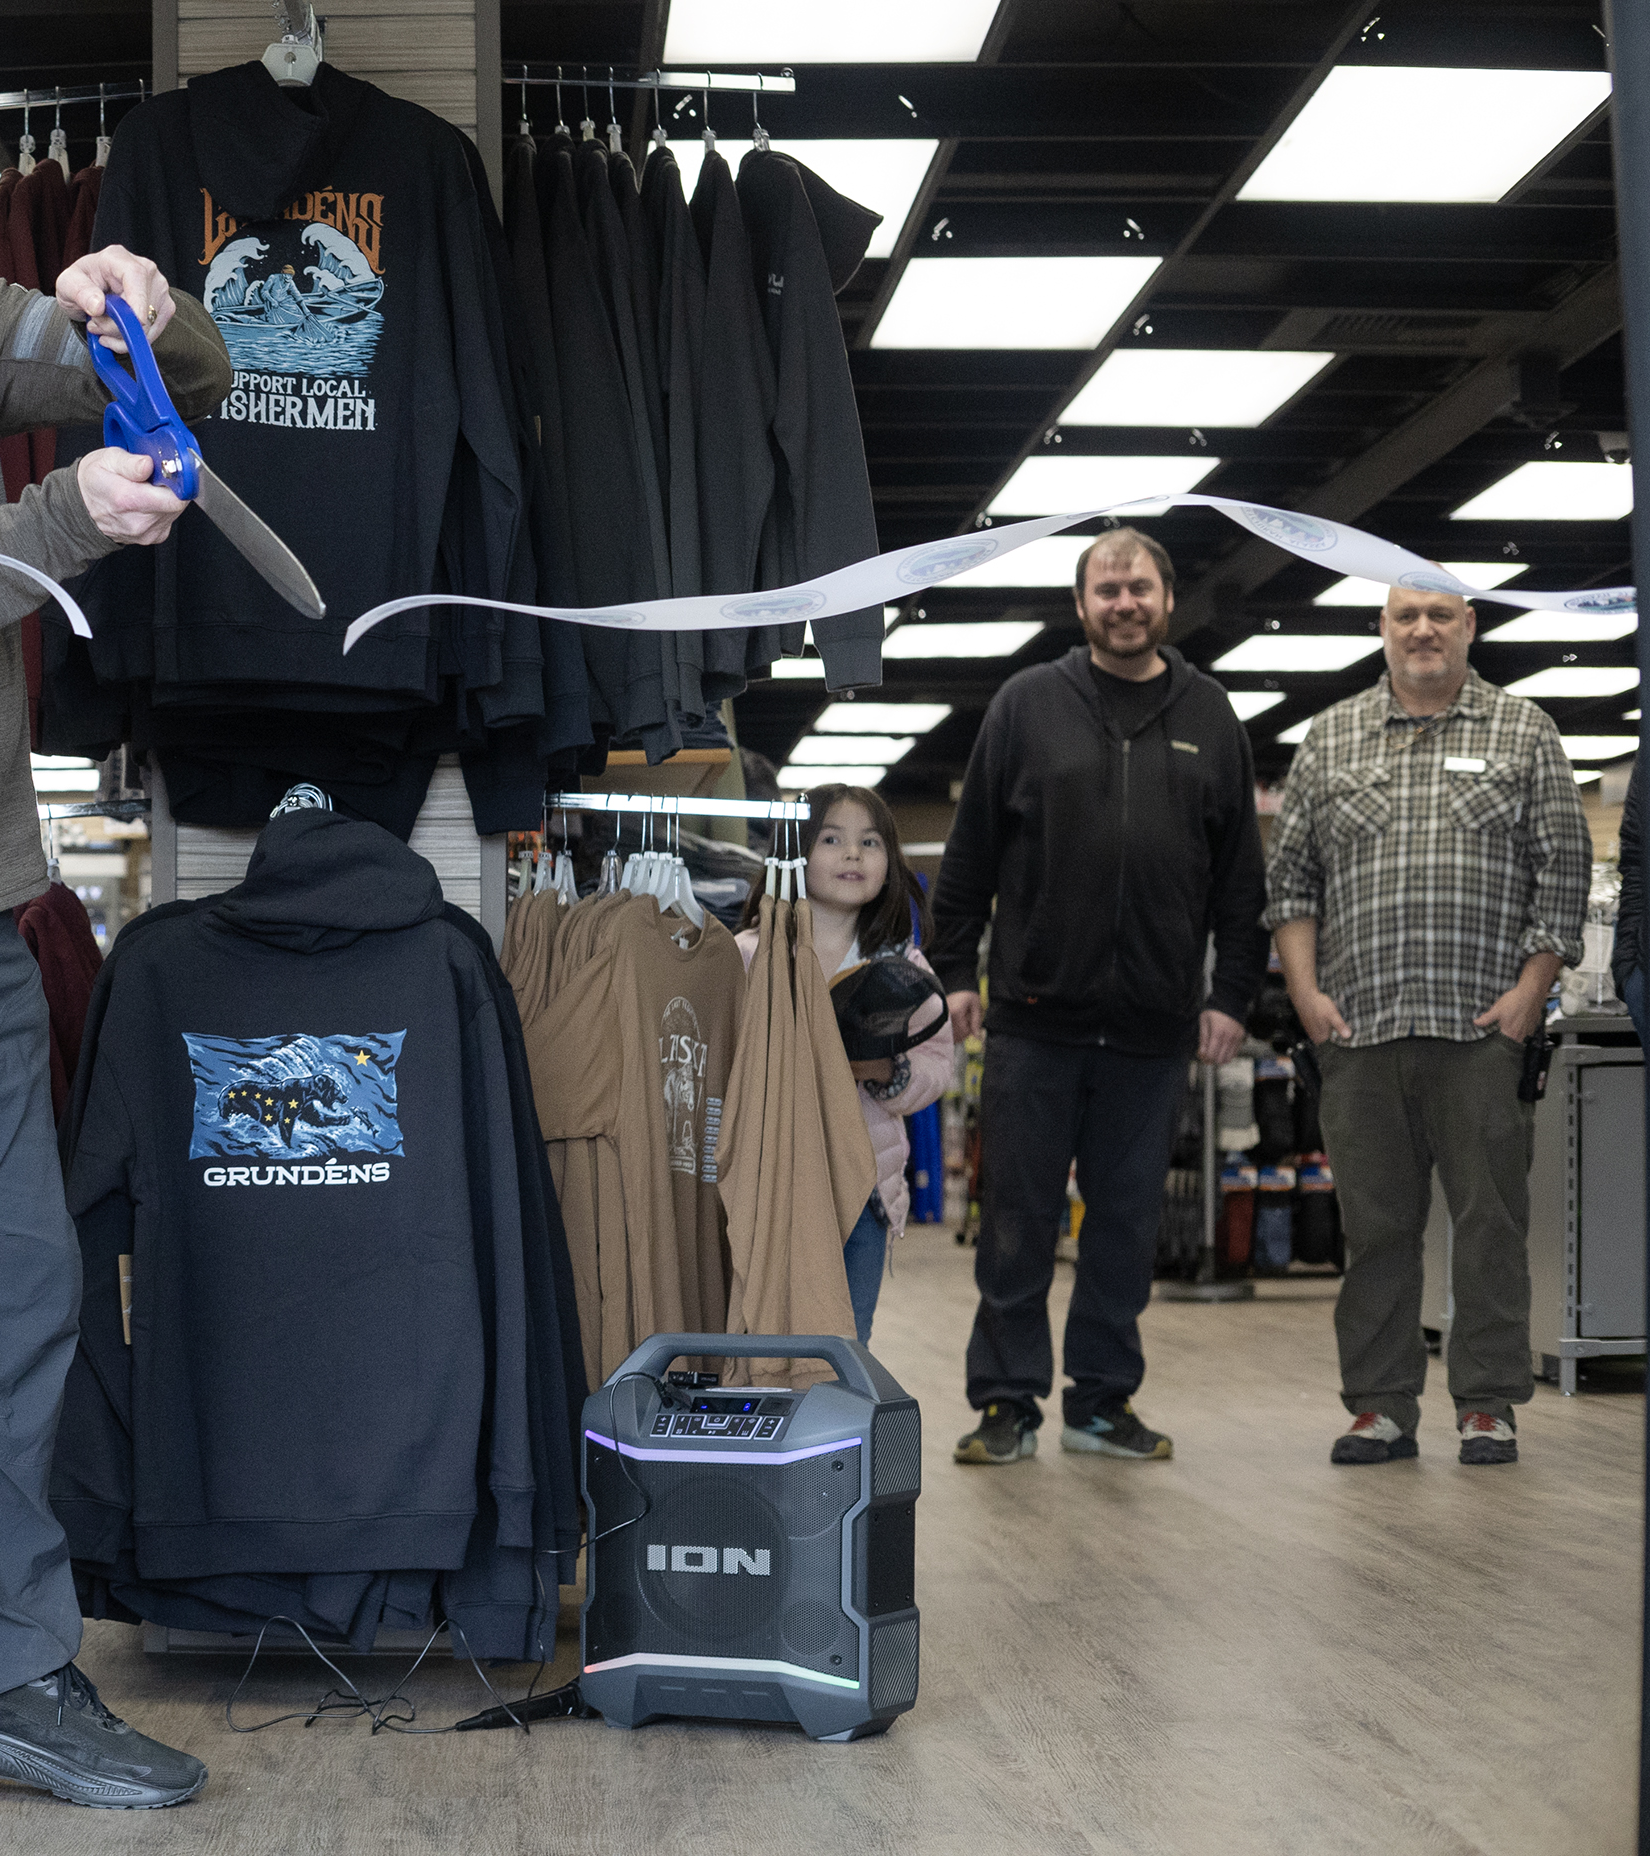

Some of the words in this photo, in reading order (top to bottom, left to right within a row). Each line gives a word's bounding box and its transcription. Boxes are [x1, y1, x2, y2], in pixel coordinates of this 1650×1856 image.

[231, 373, 297, 395] UPPORT
[302, 378, 366, 397] LOCAL
[205, 391, 376, 431] ISHERMEN
[659, 1034, 708, 1077] LASKA
[203, 1158, 390, 1186] GRUNDÉNS
[647, 1544, 771, 1576] ION
